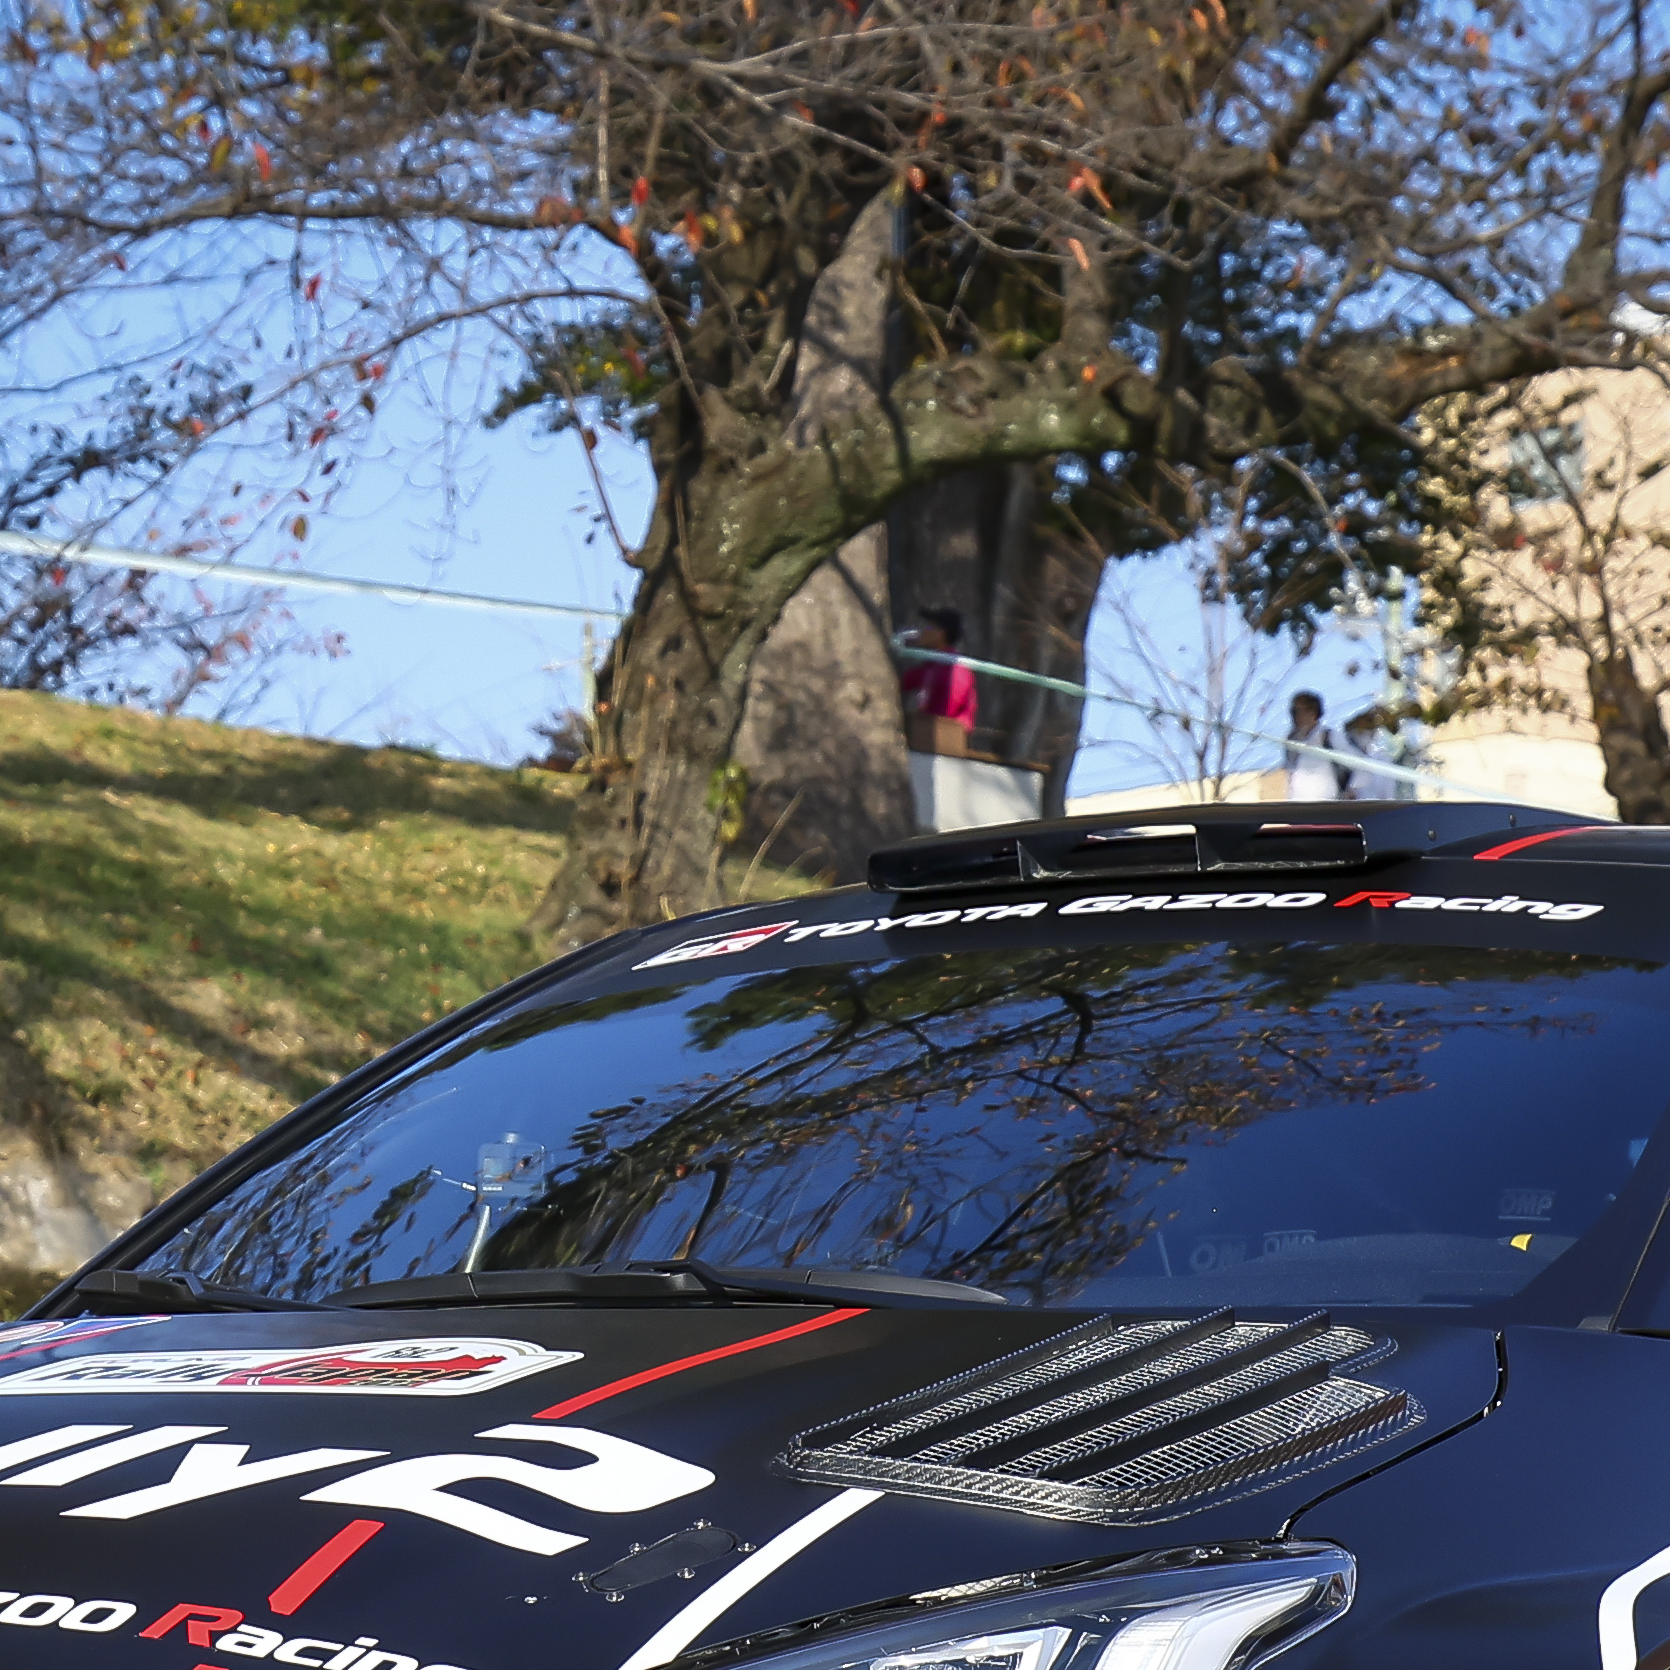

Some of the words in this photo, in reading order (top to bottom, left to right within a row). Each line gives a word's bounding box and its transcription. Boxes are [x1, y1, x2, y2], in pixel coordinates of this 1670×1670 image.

[783, 902, 1048, 942] TOYOTA
[1058, 891, 1327, 914] GAZOO
[1333, 890, 1605, 920] Racing
[26, 1363, 254, 1384] Rally
[235, 1361, 495, 1384] Japan
